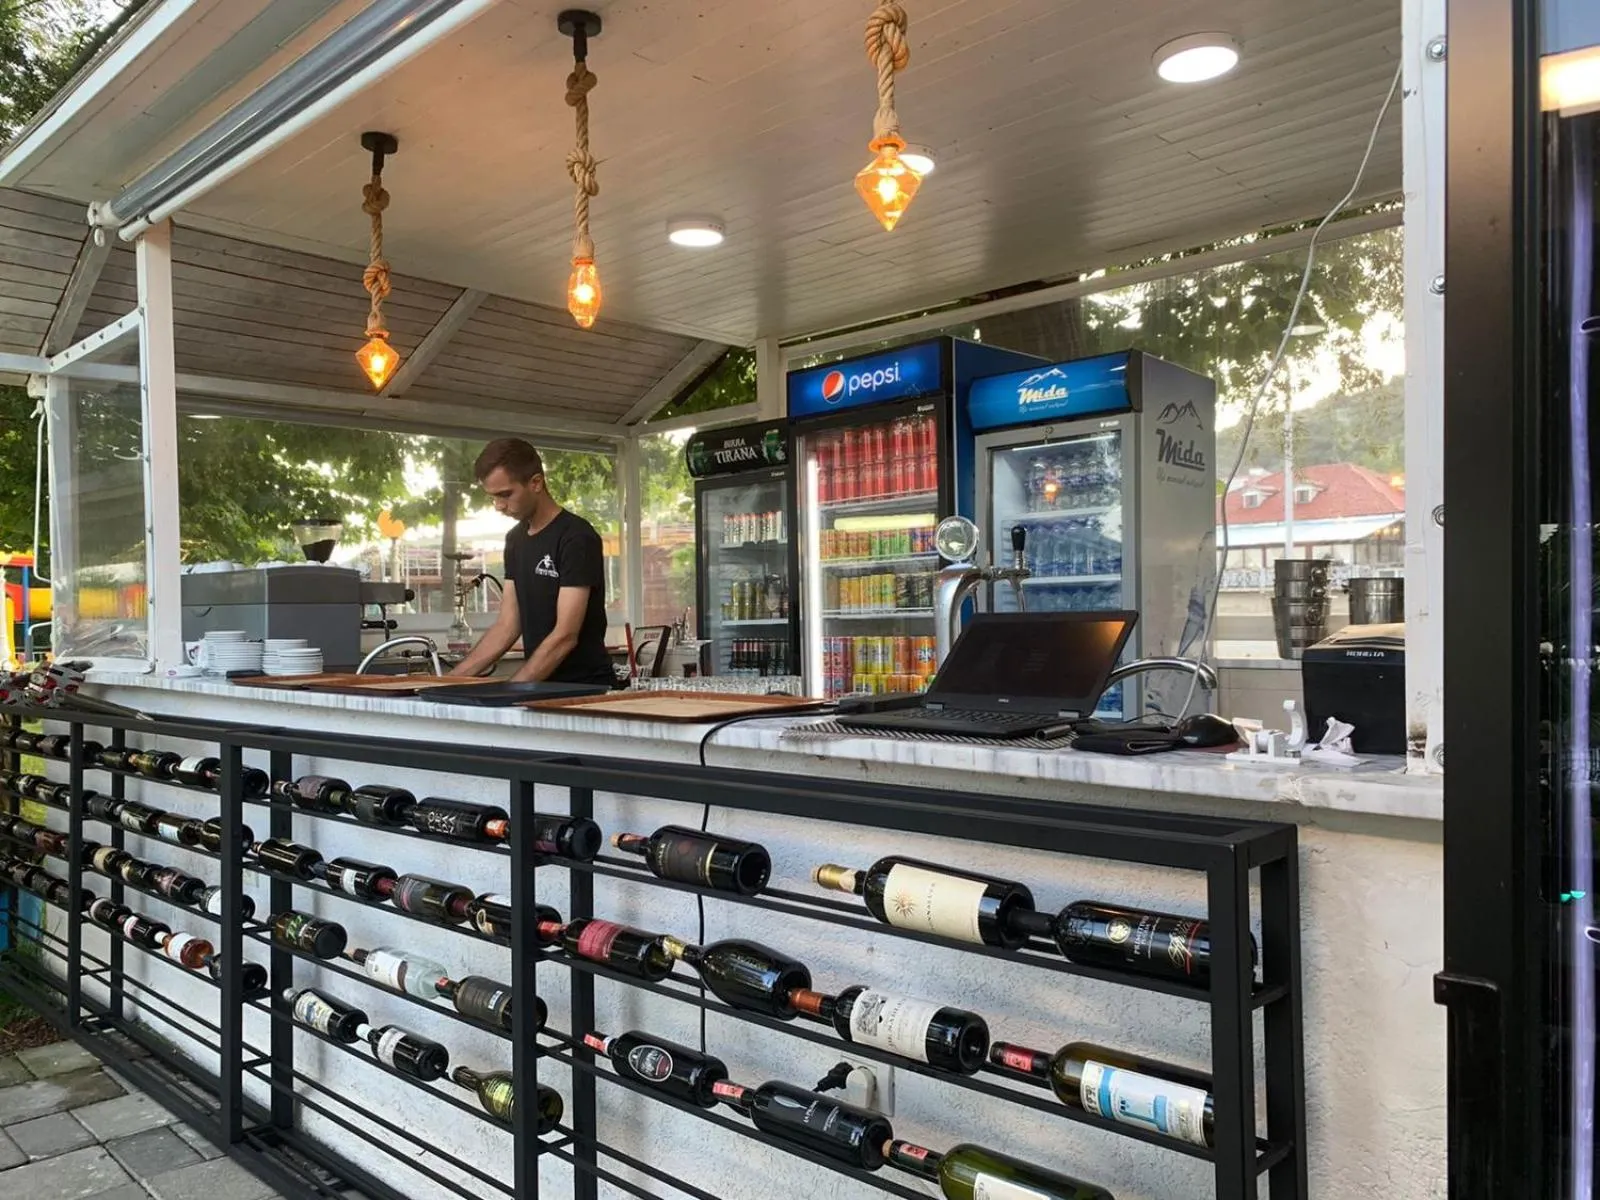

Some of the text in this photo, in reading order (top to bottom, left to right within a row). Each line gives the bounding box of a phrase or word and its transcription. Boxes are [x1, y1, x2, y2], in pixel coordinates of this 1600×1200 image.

[848, 361, 900, 397] pepsi
[1016, 384, 1069, 405] Mida
[714, 446, 758, 464] TIRANA
[1155, 427, 1206, 471] Mida
